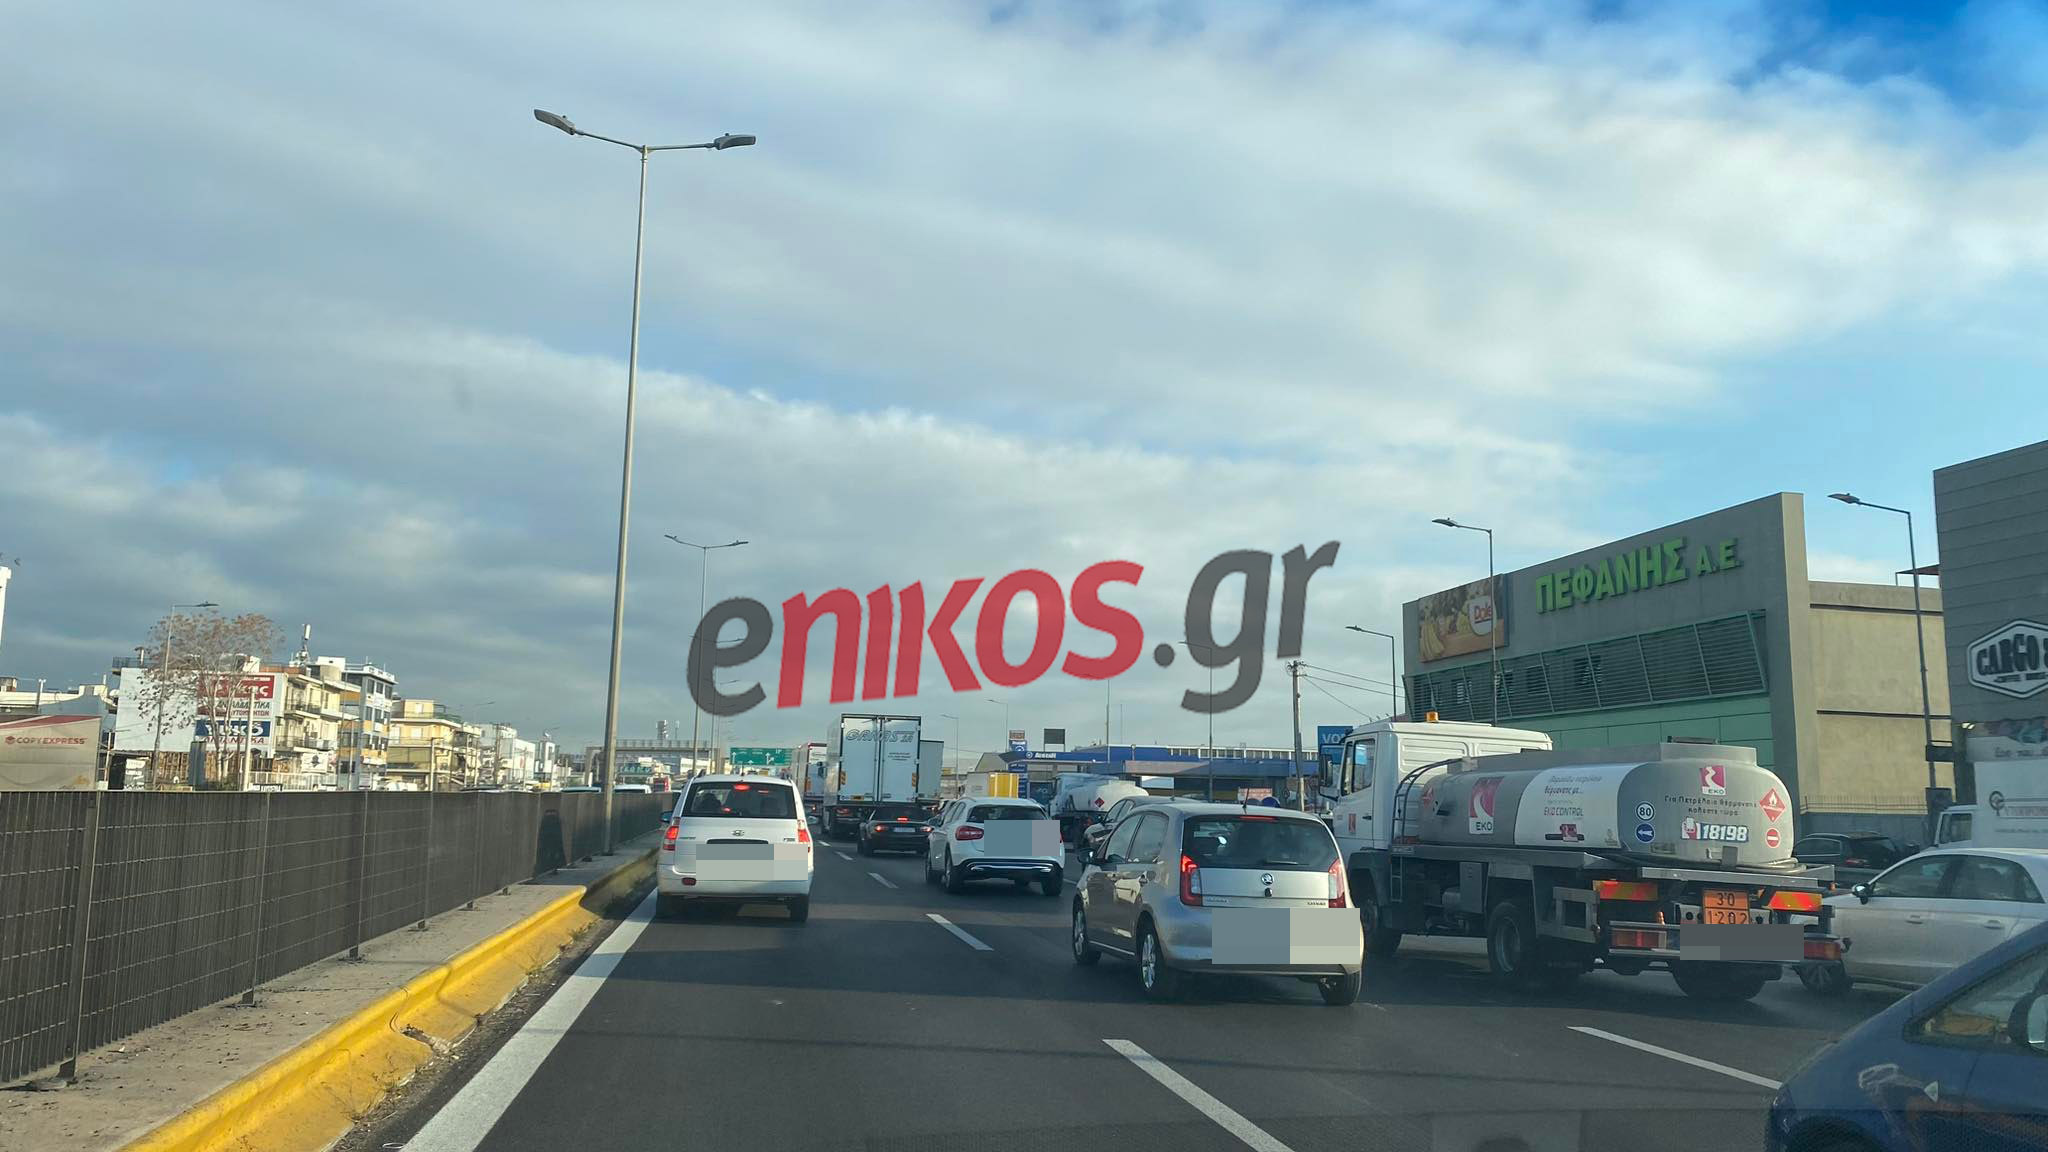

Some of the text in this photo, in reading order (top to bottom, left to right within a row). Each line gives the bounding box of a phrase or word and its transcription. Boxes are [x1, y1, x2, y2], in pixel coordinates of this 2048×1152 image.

[1535, 536, 1689, 615] ΠΕΦΑΝΗΣ
[1474, 604, 1492, 620] Dole
[1976, 633, 2040, 676] CARGO
[16, 737, 87, 745] COPYEXPRESS
[1664, 795, 1677, 803] Για
[1556, 806, 1584, 817] CONTROL
[1639, 806, 1652, 817] 80
[1475, 821, 1493, 831] EKO
[1702, 824, 1748, 841] 18198
[1717, 893, 1735, 906] 30
[1708, 911, 1748, 924] 1202
